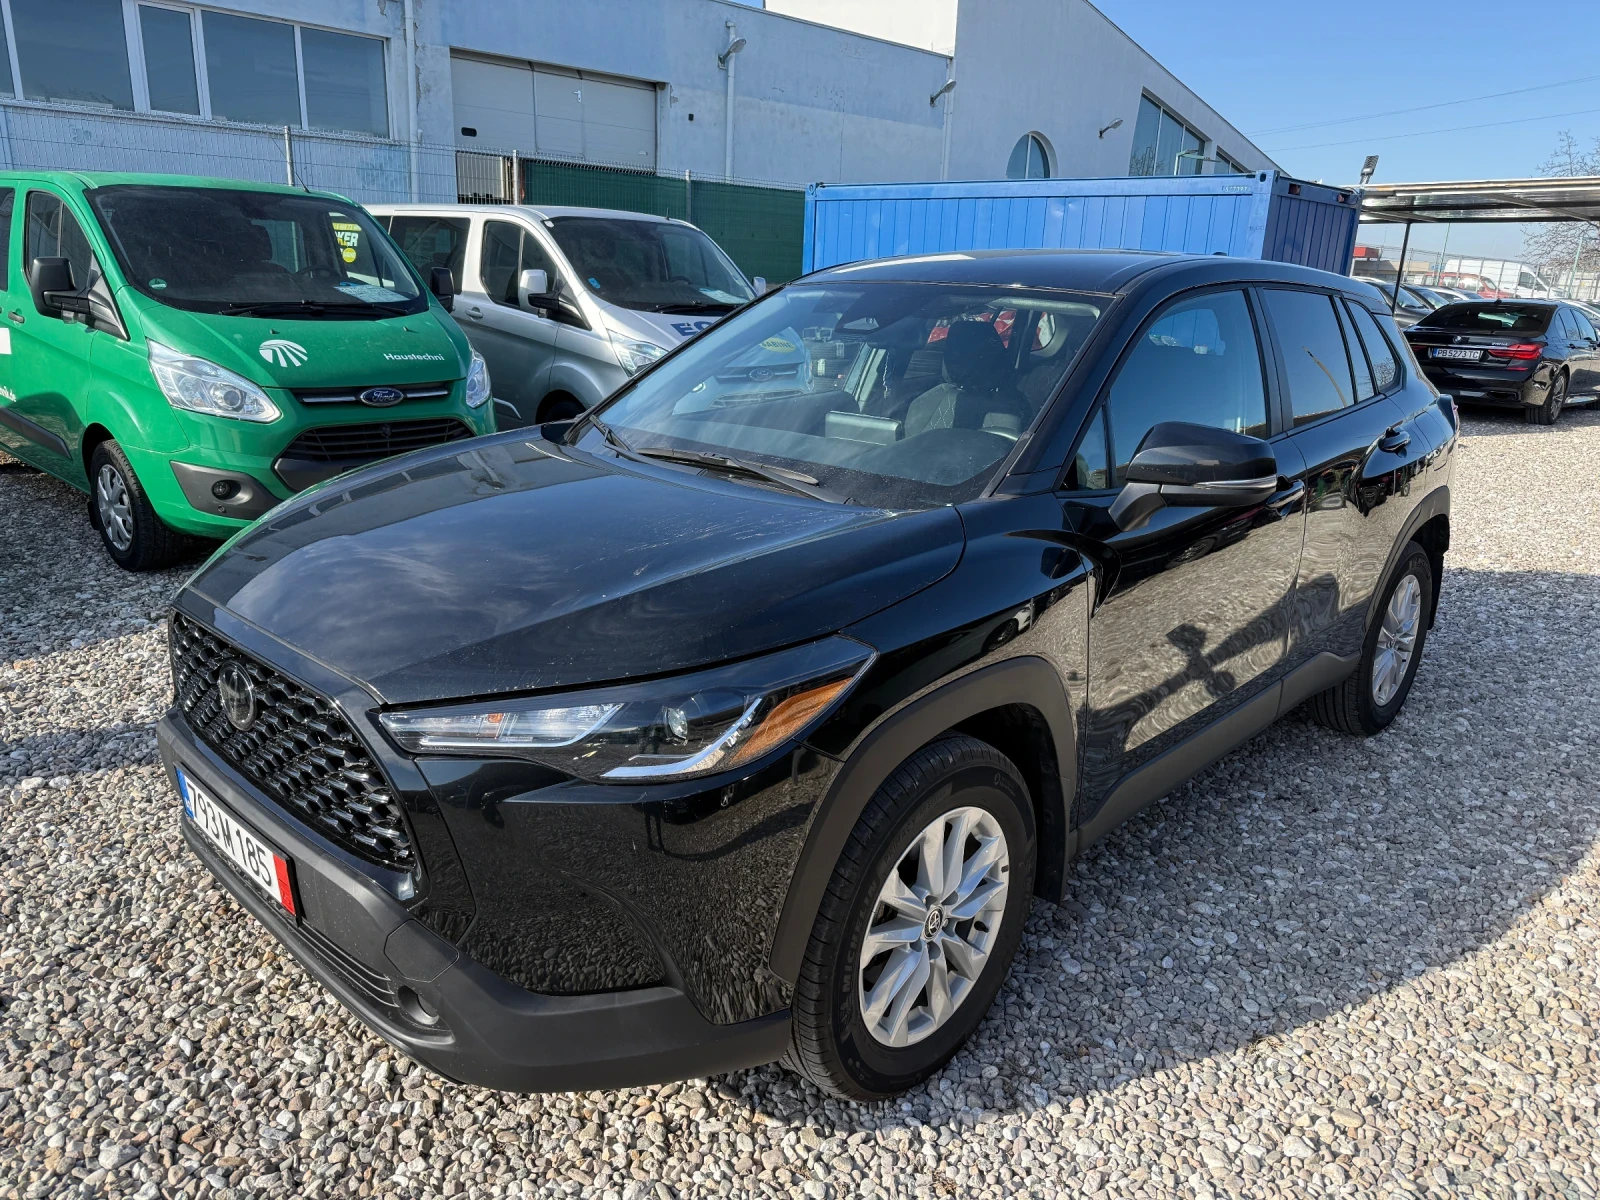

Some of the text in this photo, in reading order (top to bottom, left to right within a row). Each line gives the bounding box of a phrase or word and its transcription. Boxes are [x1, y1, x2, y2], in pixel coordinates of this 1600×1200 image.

[383, 353, 445, 361] Haustechni
[371, 390, 395, 402] Ford
[842, 879, 877, 993] MICHELIN
